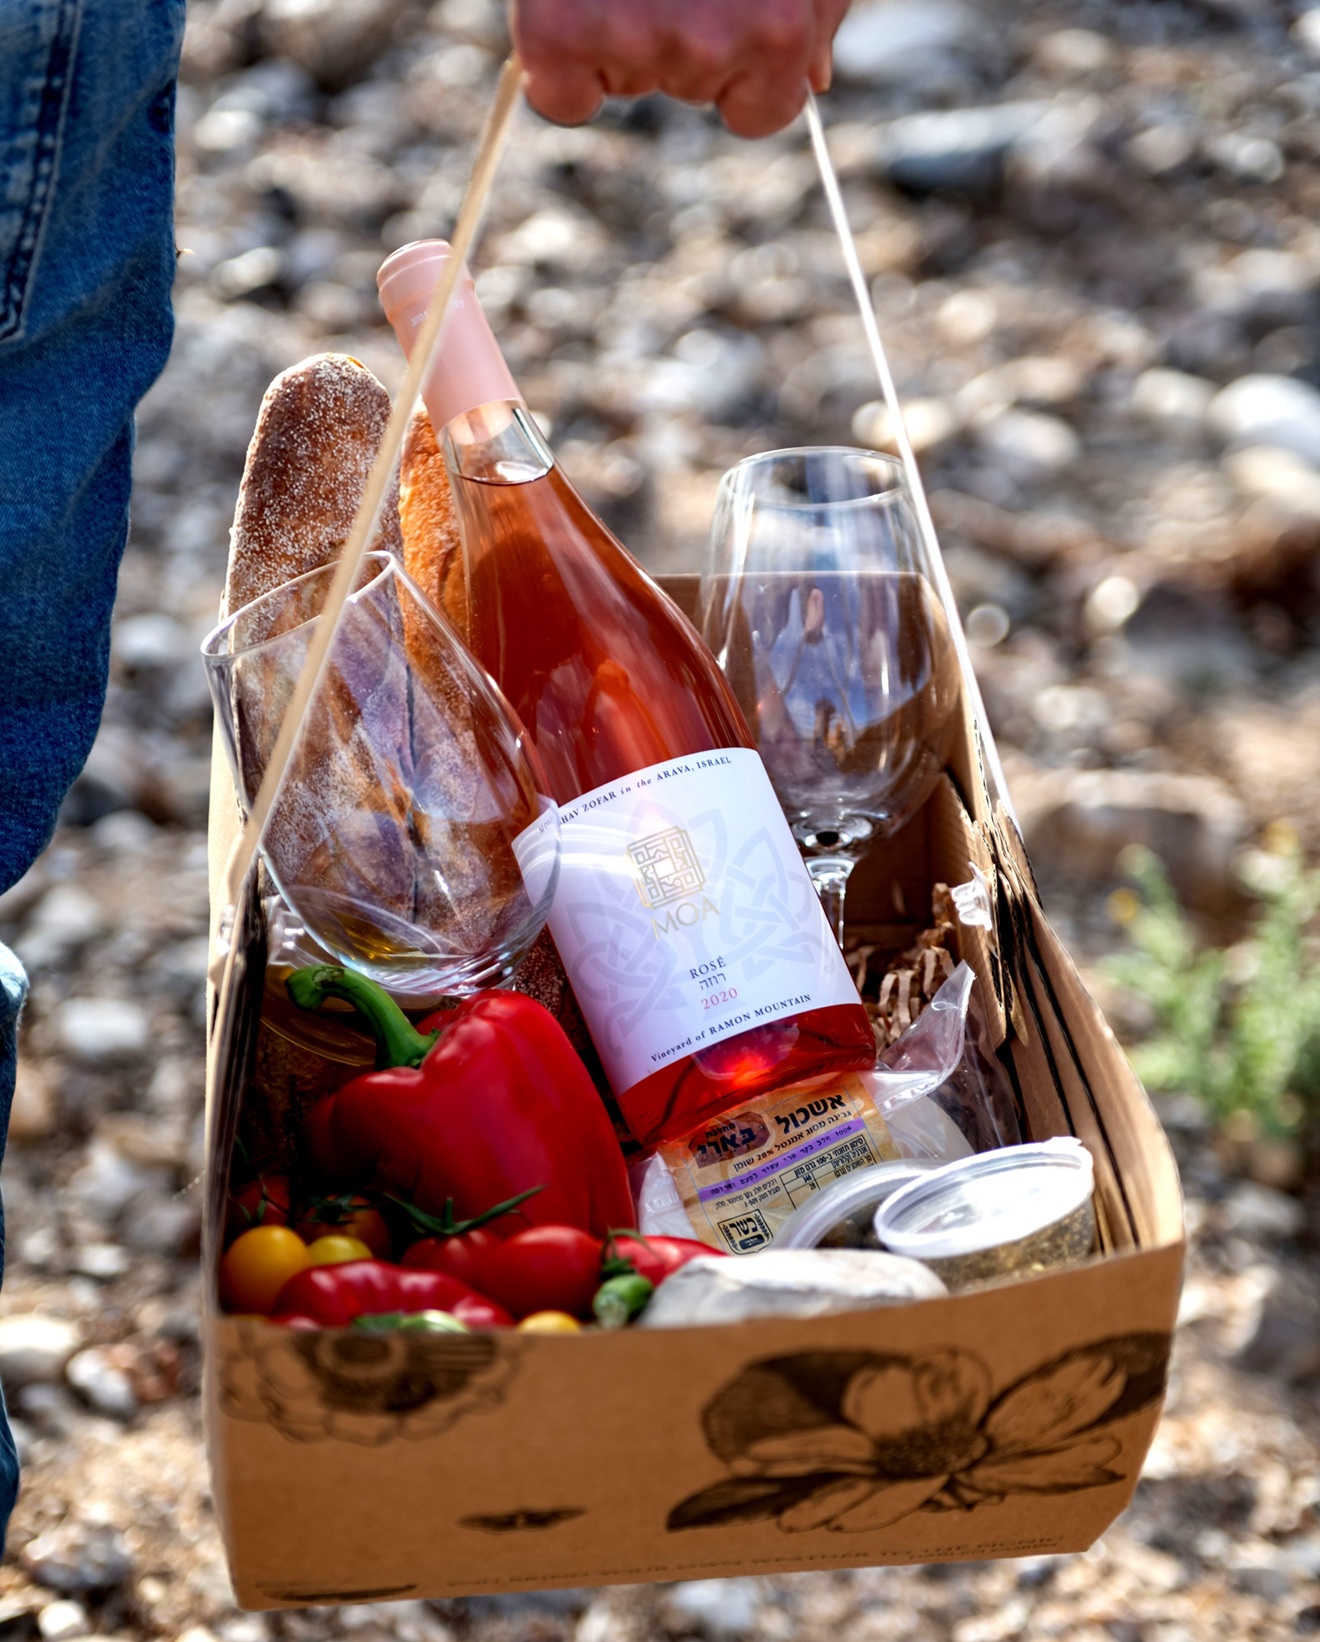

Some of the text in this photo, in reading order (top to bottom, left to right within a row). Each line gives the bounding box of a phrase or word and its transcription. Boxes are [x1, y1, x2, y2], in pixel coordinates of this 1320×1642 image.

[582, 791, 617, 812] ZOFAR
[620, 785, 632, 795] in
[636, 778, 652, 789] the
[656, 764, 695, 782] ARAVA,
[696, 756, 732, 770] ISRAEL
[652, 895, 721, 940] MOA
[689, 956, 727, 979] ROSÉ
[699, 972, 727, 990] רוזה
[701, 987, 738, 1010] 2020
[651, 993, 812, 1063] Vineyard of RAMON MOUNTAIN
[774, 1094, 847, 1135] אשכול
[733, 1110, 852, 1173] גבינה מסוג אמנטל 28% שומן
[729, 1217, 758, 1237] כשר
